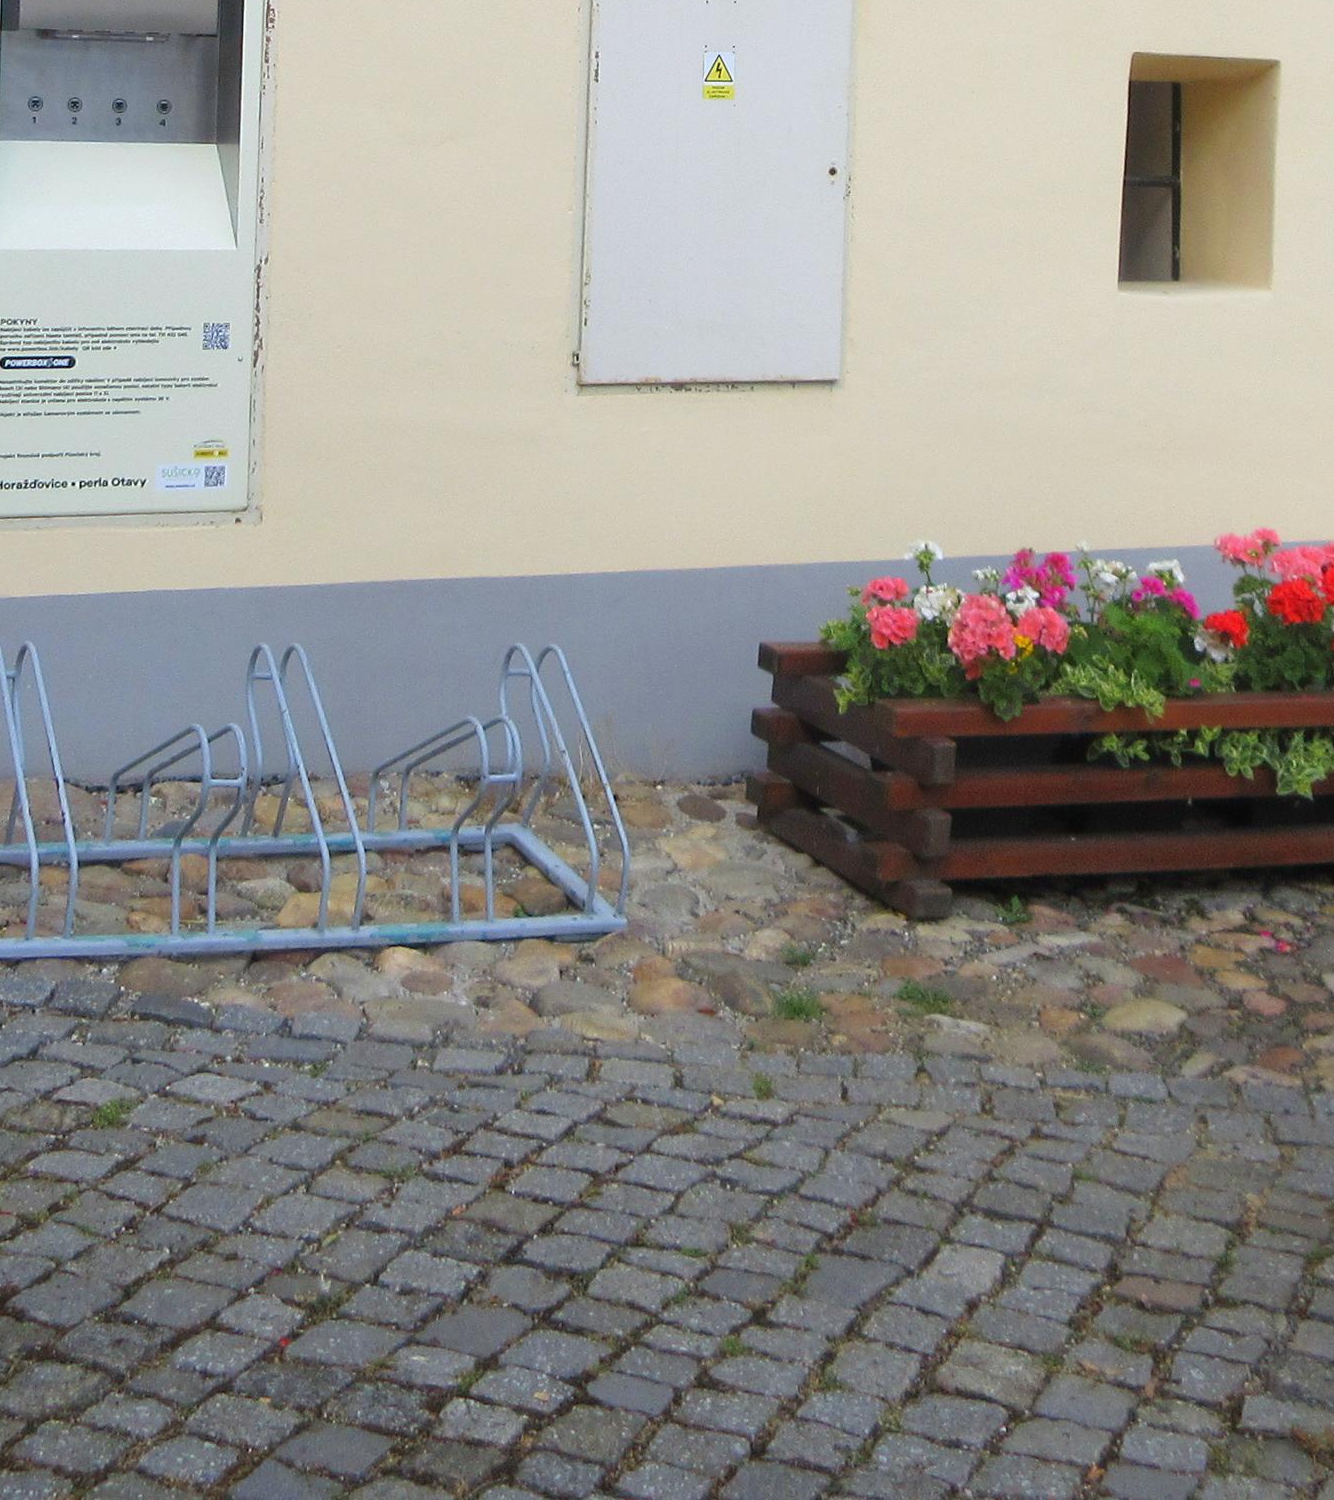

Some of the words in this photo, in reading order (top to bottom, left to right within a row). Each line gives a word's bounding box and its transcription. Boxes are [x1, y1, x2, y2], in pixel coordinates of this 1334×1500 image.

[0, 318, 38, 326] POKYNY
[79, 478, 108, 490] perla
[111, 476, 147, 489] Otavy
